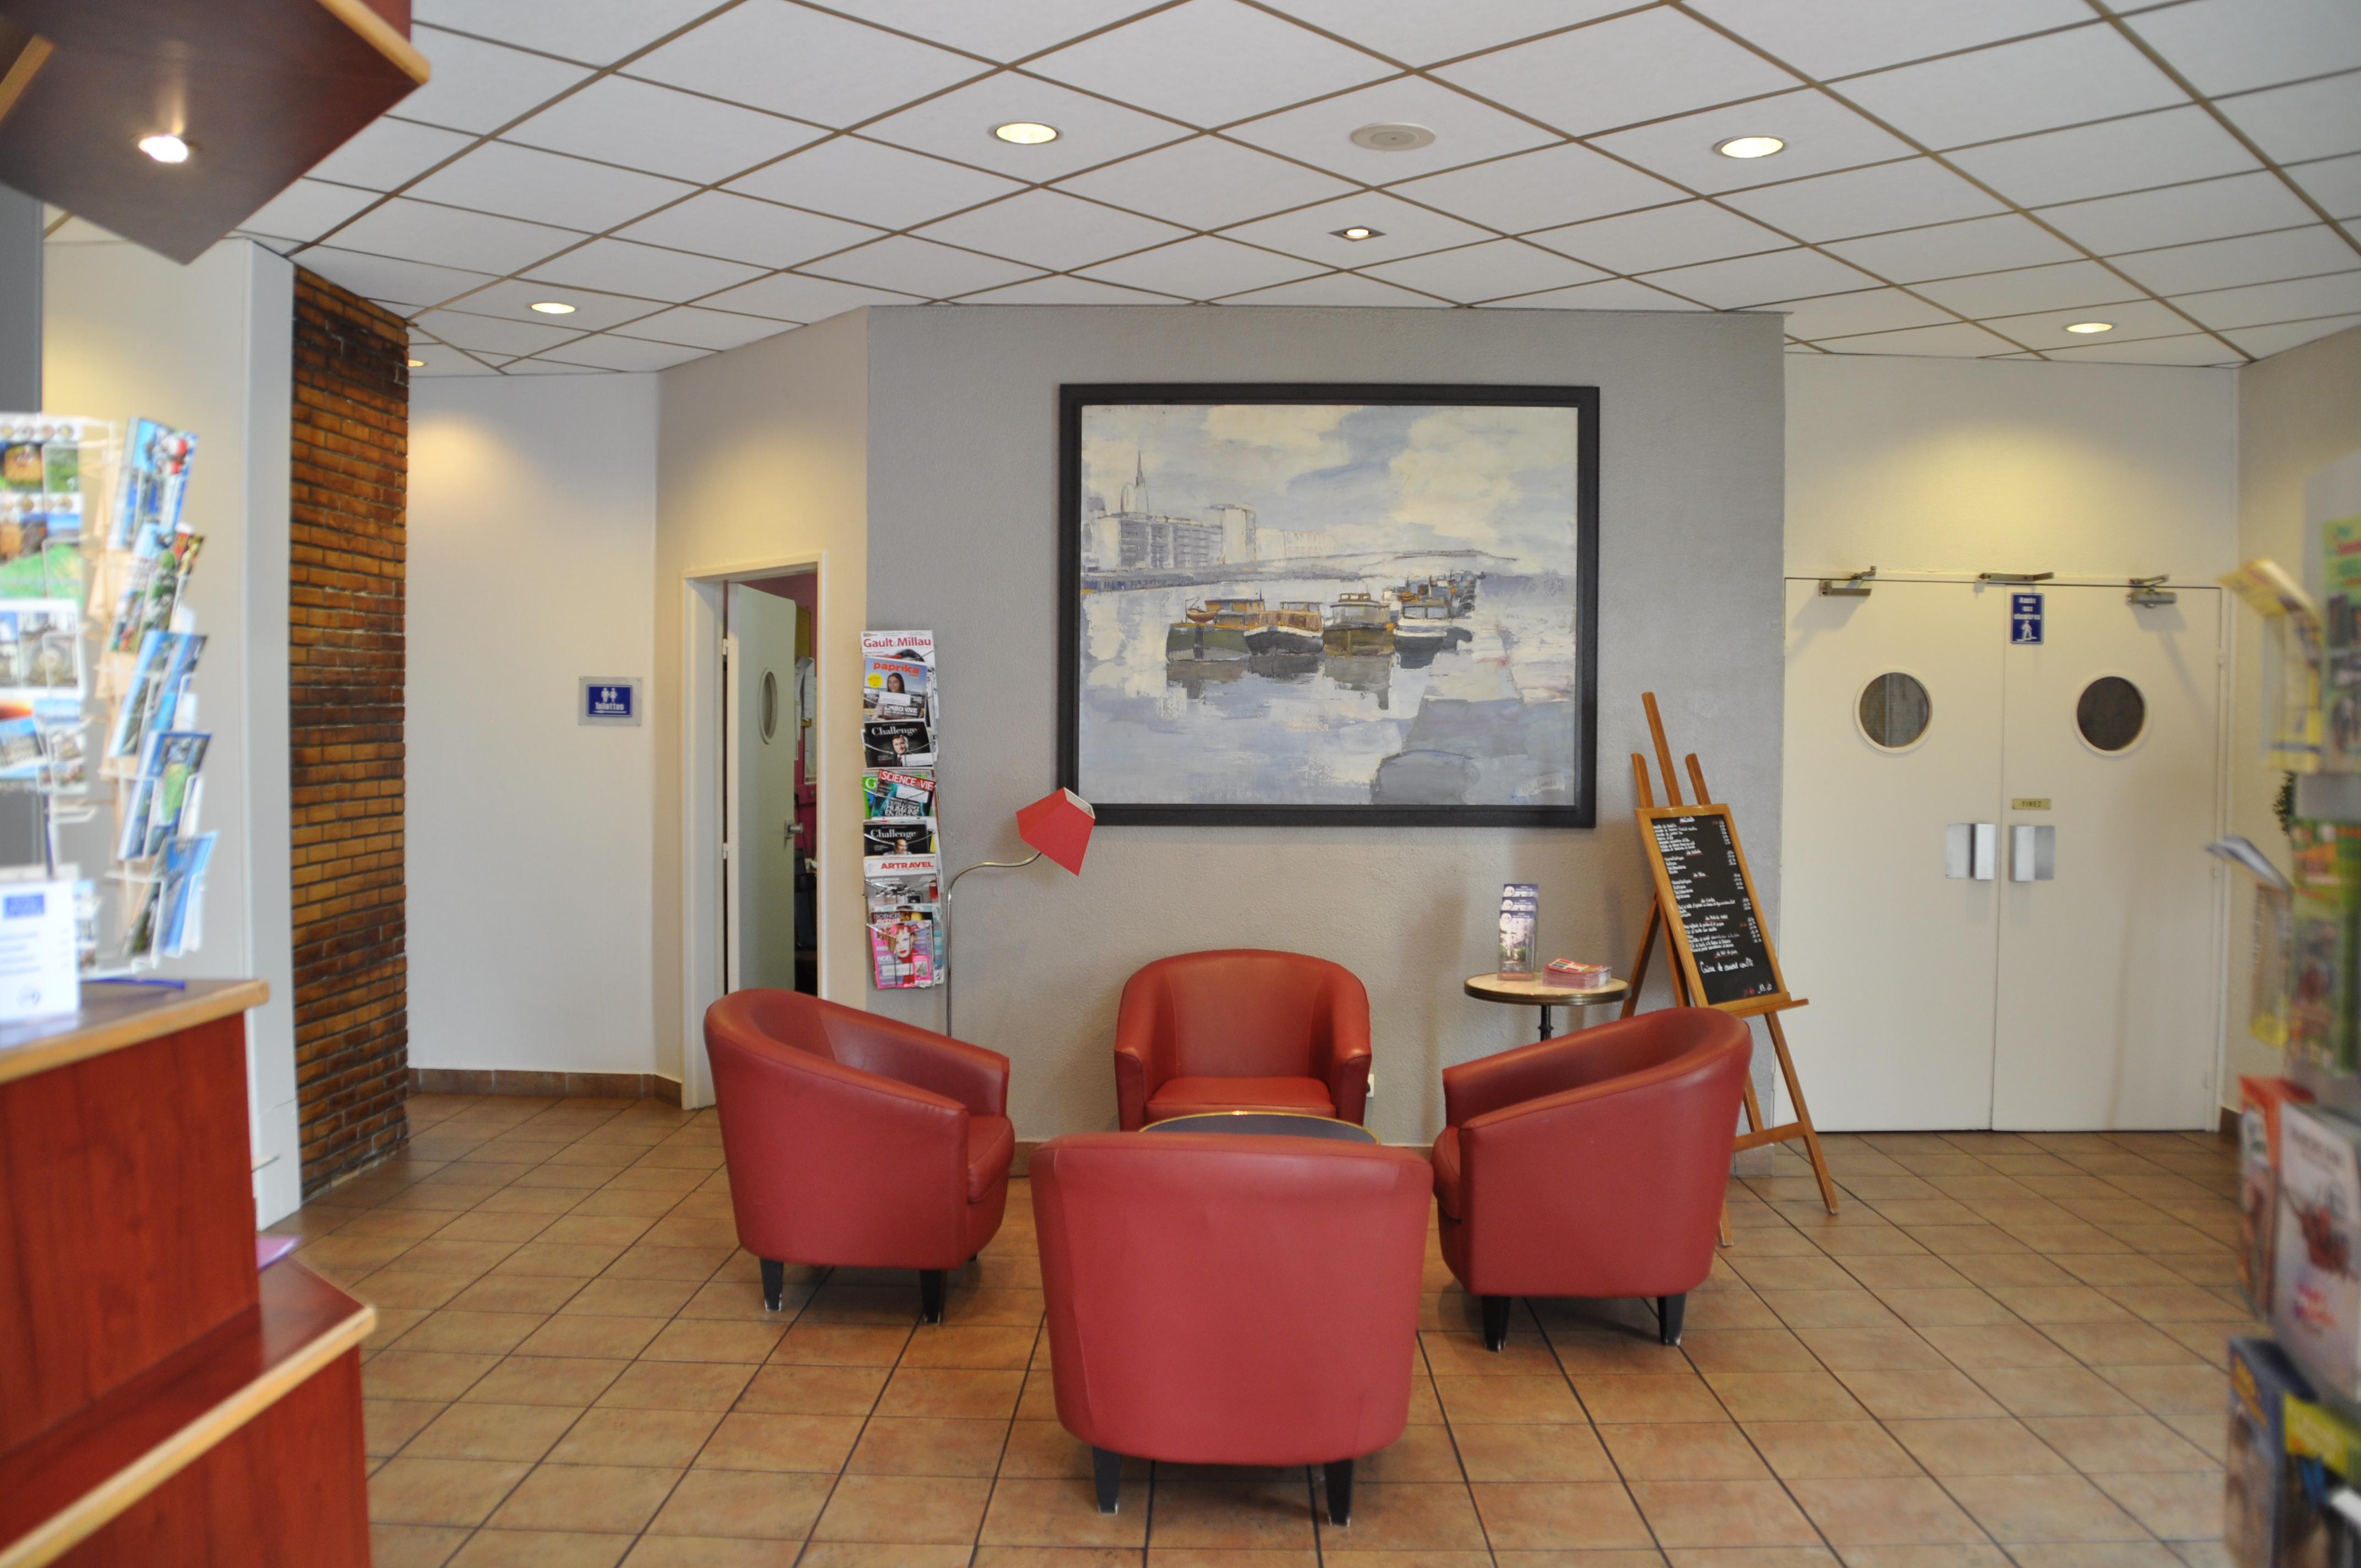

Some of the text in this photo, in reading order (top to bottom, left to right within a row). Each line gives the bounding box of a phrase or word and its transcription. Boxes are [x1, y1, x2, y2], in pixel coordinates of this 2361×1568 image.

[863, 638, 893, 647] Gault
[897, 636, 932, 646] Millau
[873, 662, 920, 674] paprika
[881, 771, 917, 786] SCIENCE
[920, 780, 934, 791] VIE
